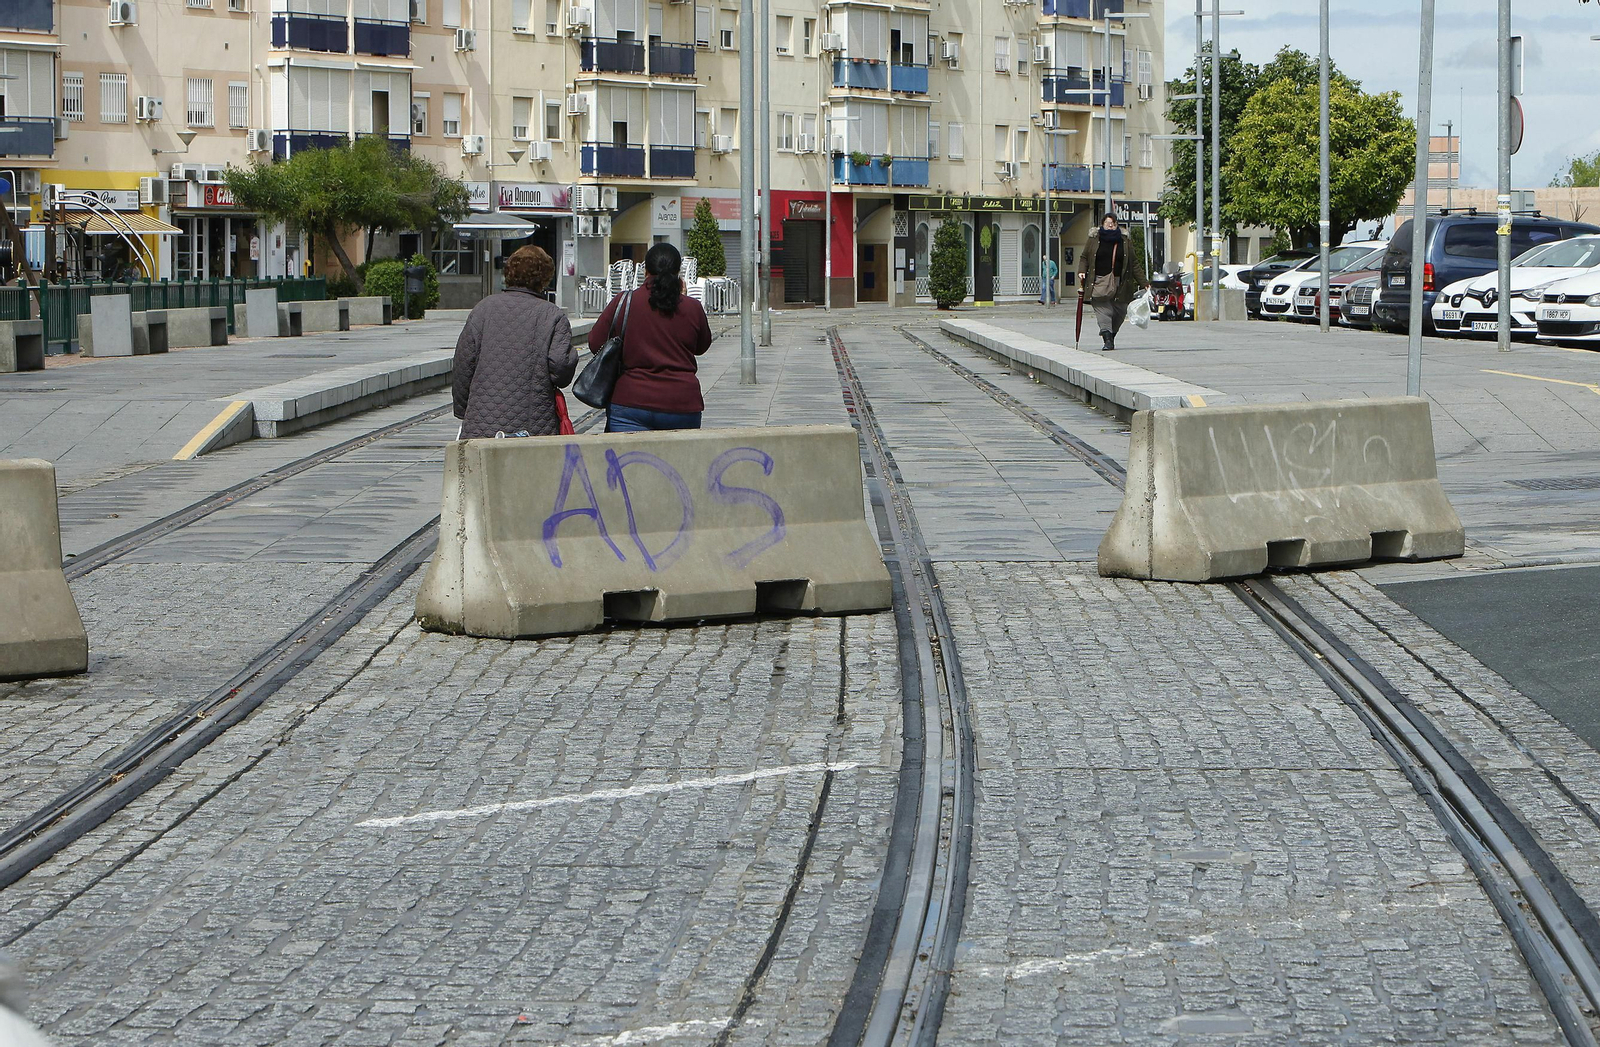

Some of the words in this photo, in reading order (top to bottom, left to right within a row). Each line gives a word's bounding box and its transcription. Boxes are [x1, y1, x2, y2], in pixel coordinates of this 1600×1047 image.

[501, 186, 513, 205] Eva
[514, 186, 541, 205] Romero
[657, 212, 677, 222] Avanza
[1475, 322, 1487, 331] 3747
[542, 443, 786, 571] ADS
